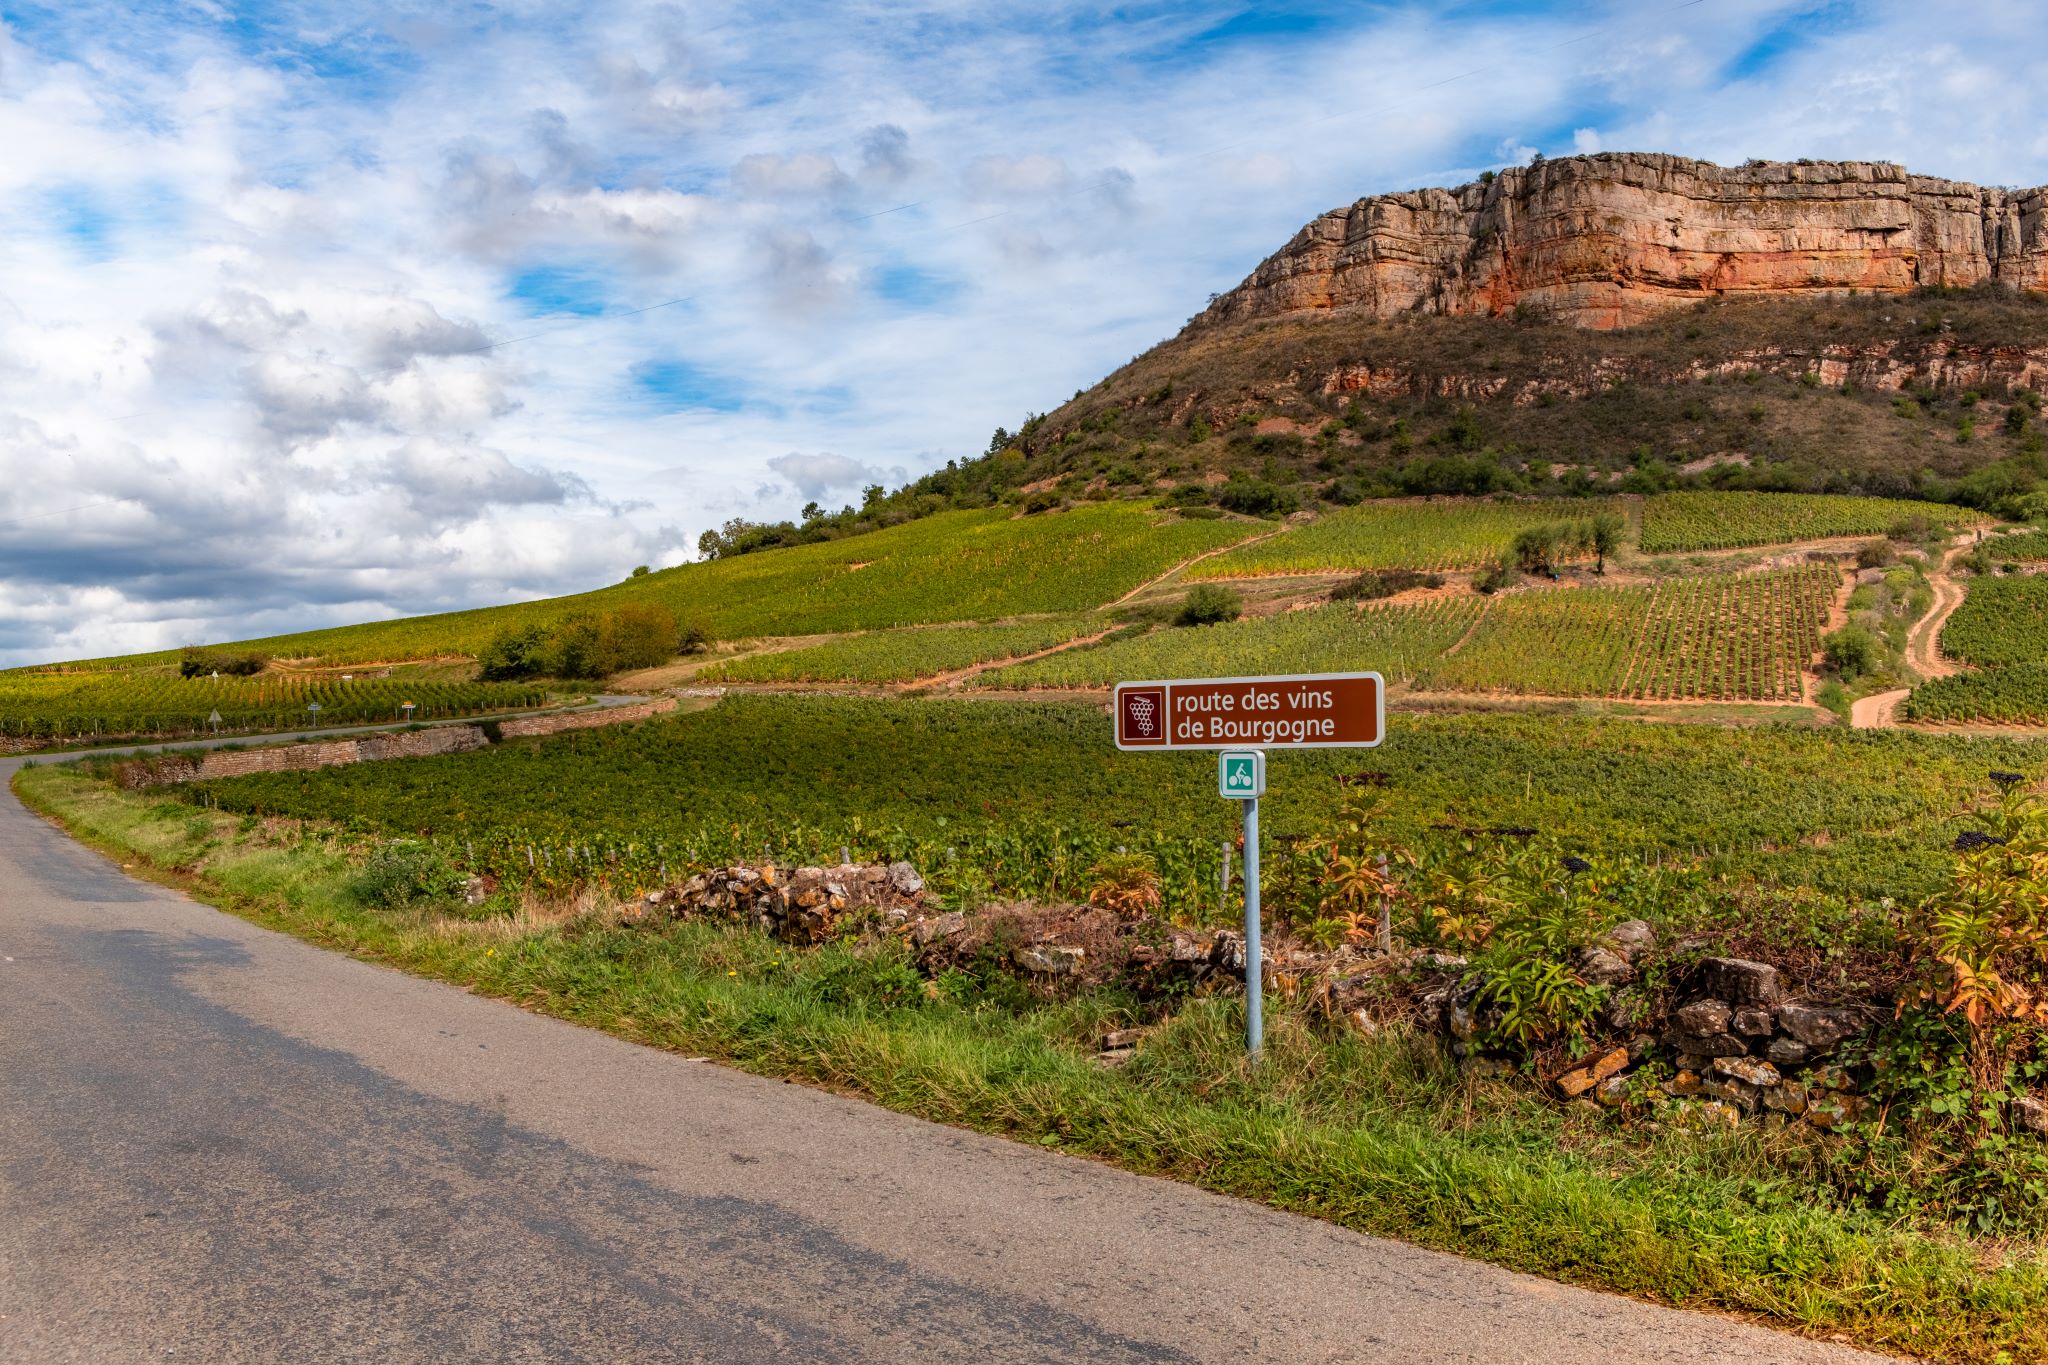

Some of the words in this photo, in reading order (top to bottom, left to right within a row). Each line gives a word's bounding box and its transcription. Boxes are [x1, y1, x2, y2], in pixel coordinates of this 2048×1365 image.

[1177, 691, 1235, 713] route
[1241, 687, 1280, 711] des
[1287, 686, 1333, 709] vins
[1177, 716, 1204, 738] de
[1210, 717, 1335, 743] Bourgogne
